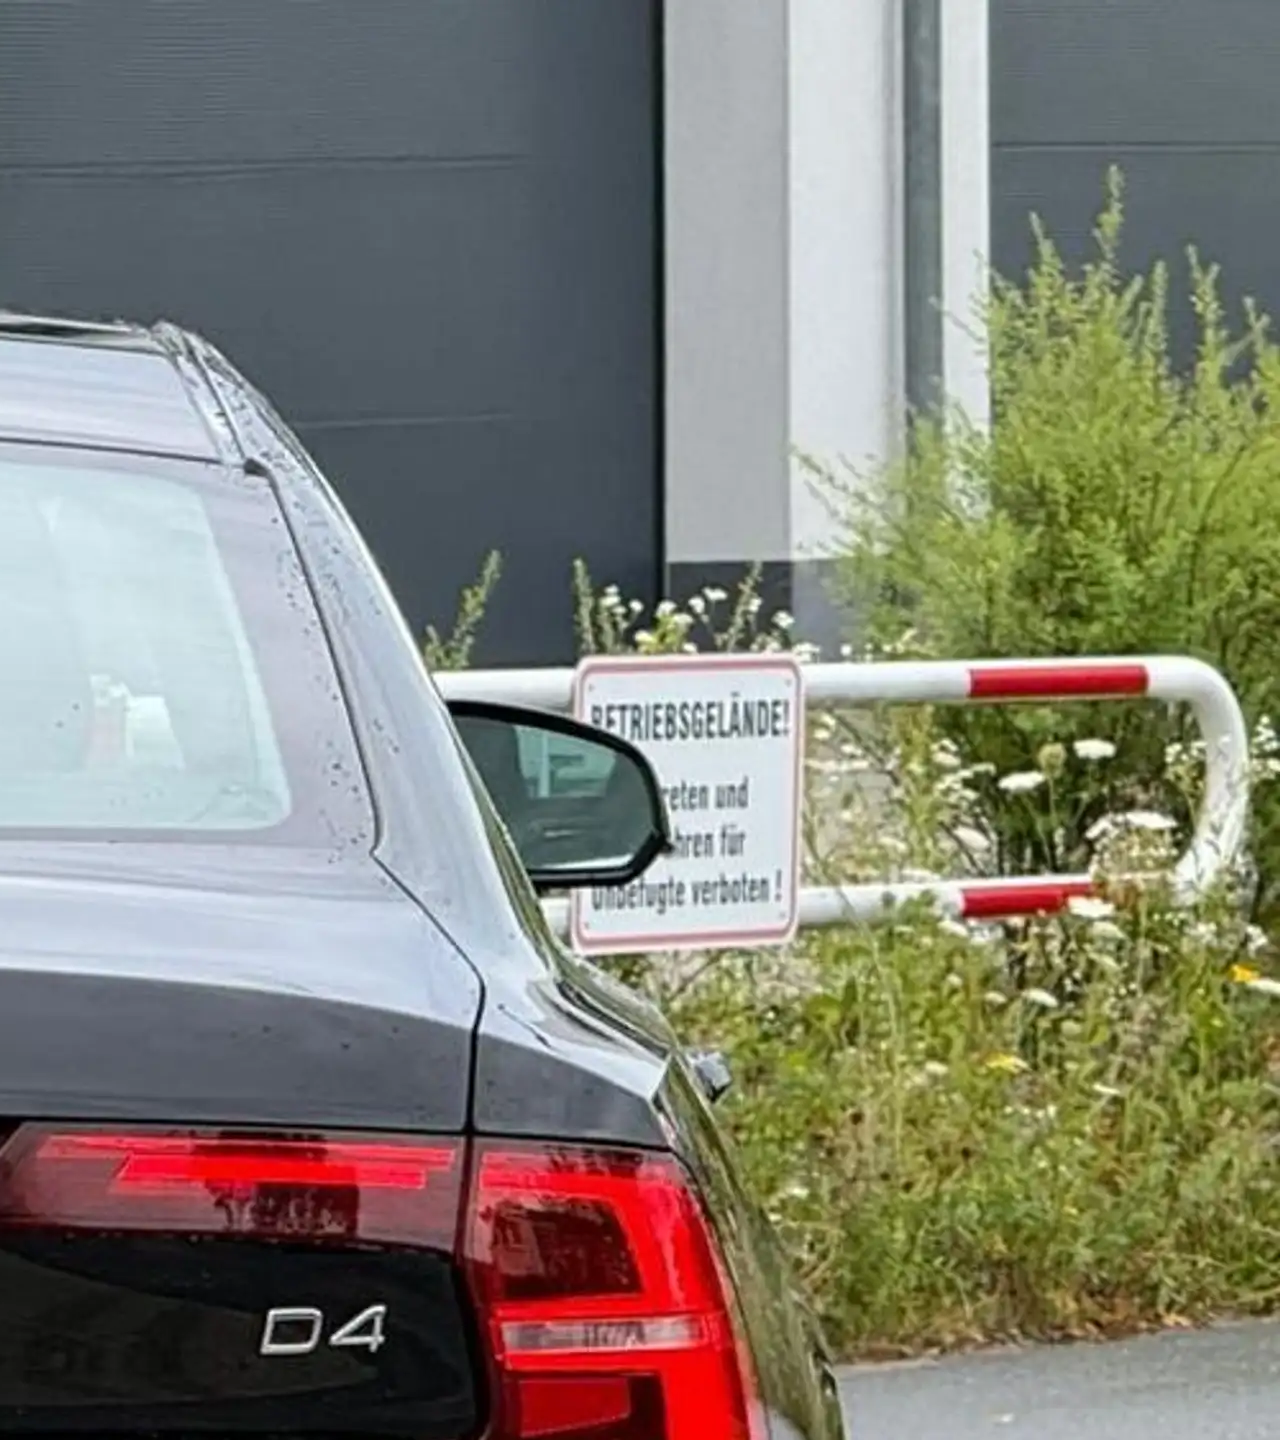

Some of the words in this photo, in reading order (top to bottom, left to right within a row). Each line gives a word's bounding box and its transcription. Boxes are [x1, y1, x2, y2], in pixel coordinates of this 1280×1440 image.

[715, 775, 749, 809] und
[721, 824, 746, 856] für
[691, 873, 769, 906] verboten
[259, 1303, 386, 1355] D4
